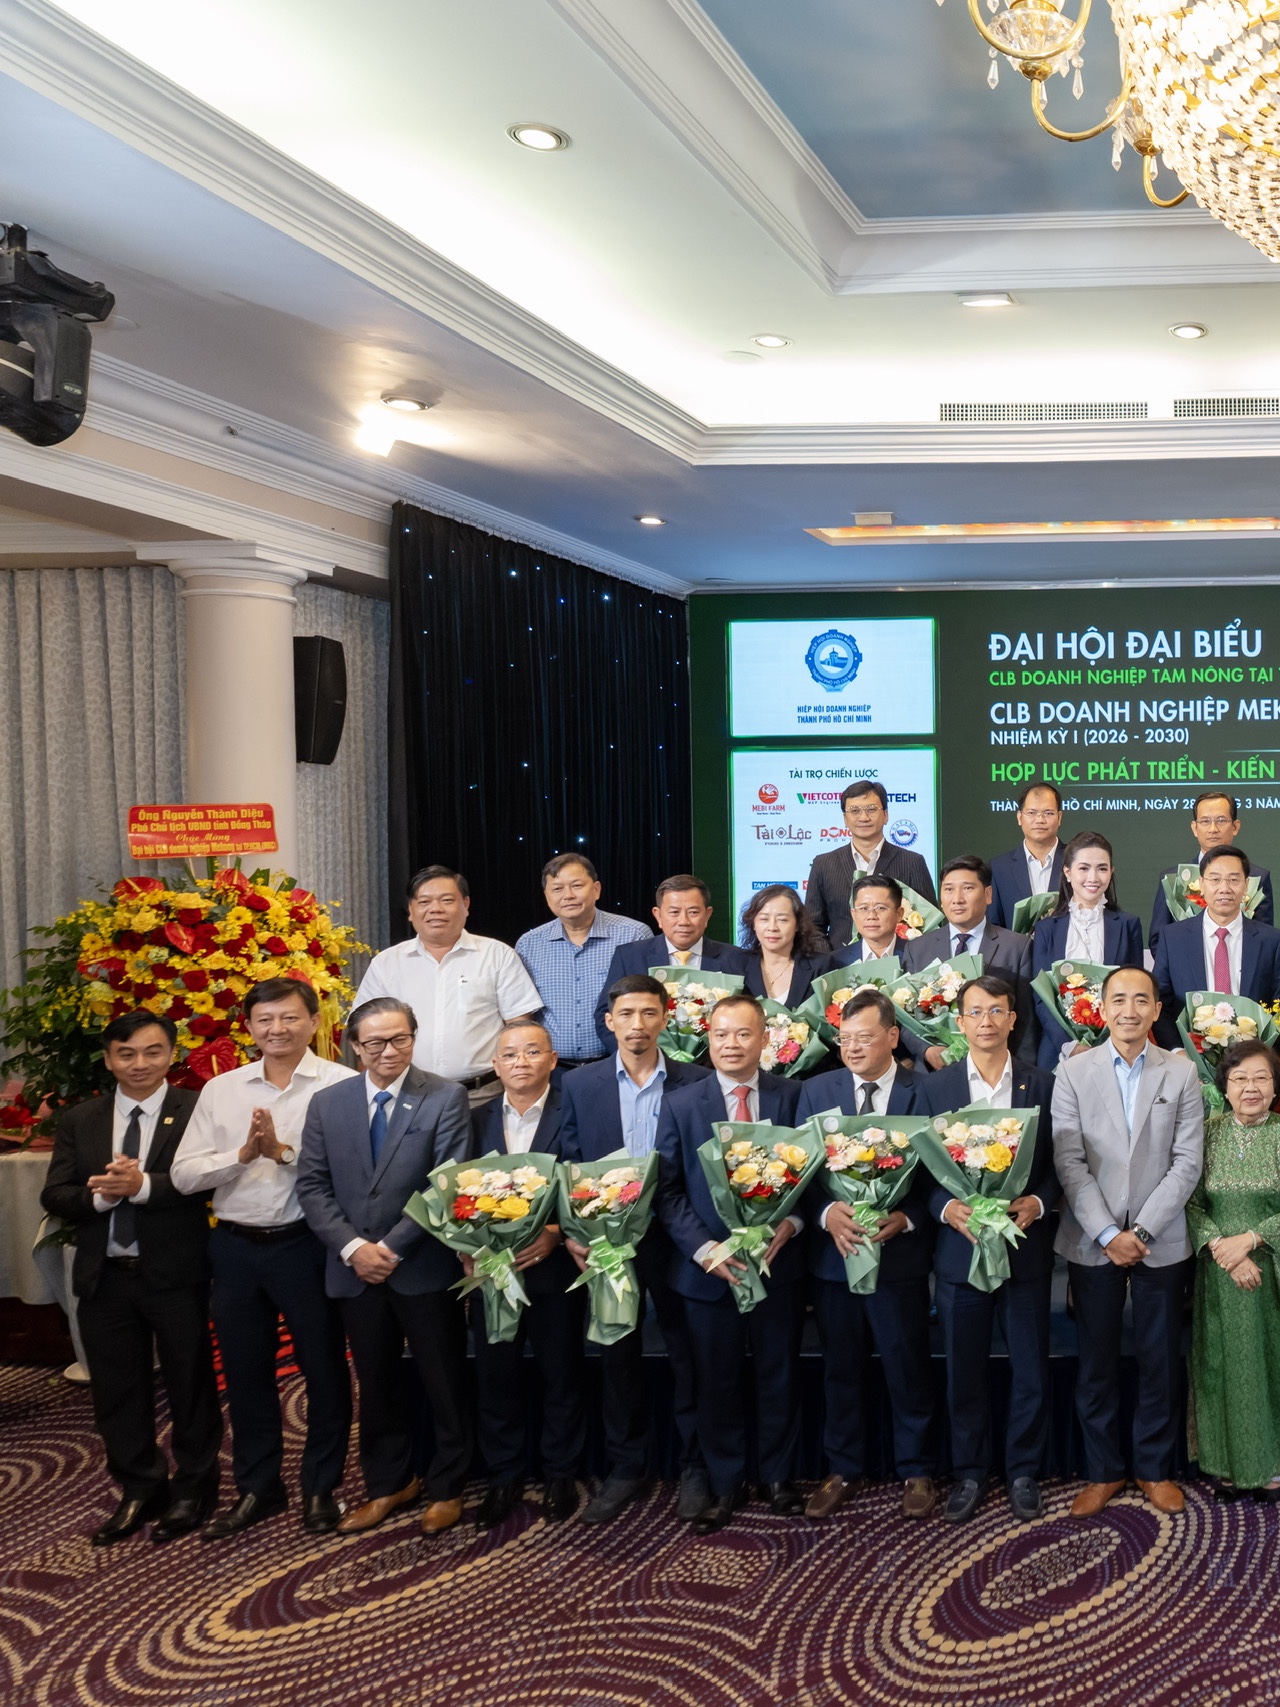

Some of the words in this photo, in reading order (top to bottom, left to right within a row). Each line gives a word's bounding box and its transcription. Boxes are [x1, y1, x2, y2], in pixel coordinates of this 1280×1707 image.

[989, 632, 1043, 665] ĐẠI
[1057, 626, 1114, 666] HỘI
[1126, 631, 1180, 663] ĐẠI
[1194, 618, 1262, 658] BIỂU
[989, 671, 1016, 685] CLB
[1022, 670, 1081, 685] DOANH
[1088, 667, 1146, 686] NGHIỆP
[1152, 668, 1186, 683] TAM
[1192, 666, 1243, 683] NÔNG
[1249, 668, 1273, 684] TẠI
[797, 705, 811, 713] HIỆP
[814, 705, 824, 713] HỘI
[849, 704, 871, 712] NGHIỆP
[990, 702, 1030, 724] CLB
[1040, 701, 1130, 723] DOANH
[1140, 696, 1229, 726] NGHIỆP
[798, 714, 817, 723] THÀNH
[819, 714, 831, 723] PHỐ
[833, 714, 841, 722] HỒ
[991, 728, 1042, 747] NHIỆM
[1048, 727, 1068, 745] KỲ
[1074, 730, 1077, 744] I
[1084, 729, 1128, 746] (2026
[1145, 728, 1189, 745] 2030)
[789, 767, 802, 778] TÀI
[806, 769, 823, 780] TRỢ
[826, 767, 852, 778] CHIẾN
[855, 769, 878, 778] LƯỢC
[992, 762, 1035, 785] HỢP
[1043, 761, 1080, 785] LỰC
[1088, 757, 1140, 781] PHÁT
[1147, 754, 1204, 779] TRIỂN
[1227, 754, 1275, 779] KIẾN
[887, 793, 916, 802] TECH
[991, 798, 1019, 812] THÀN
[1062, 797, 1079, 811] HỒ
[1084, 797, 1102, 810] CHÍ
[1107, 799, 1140, 812] MINH,
[1145, 797, 1178, 810] NGÀY
[1245, 799, 1252, 809] 3
